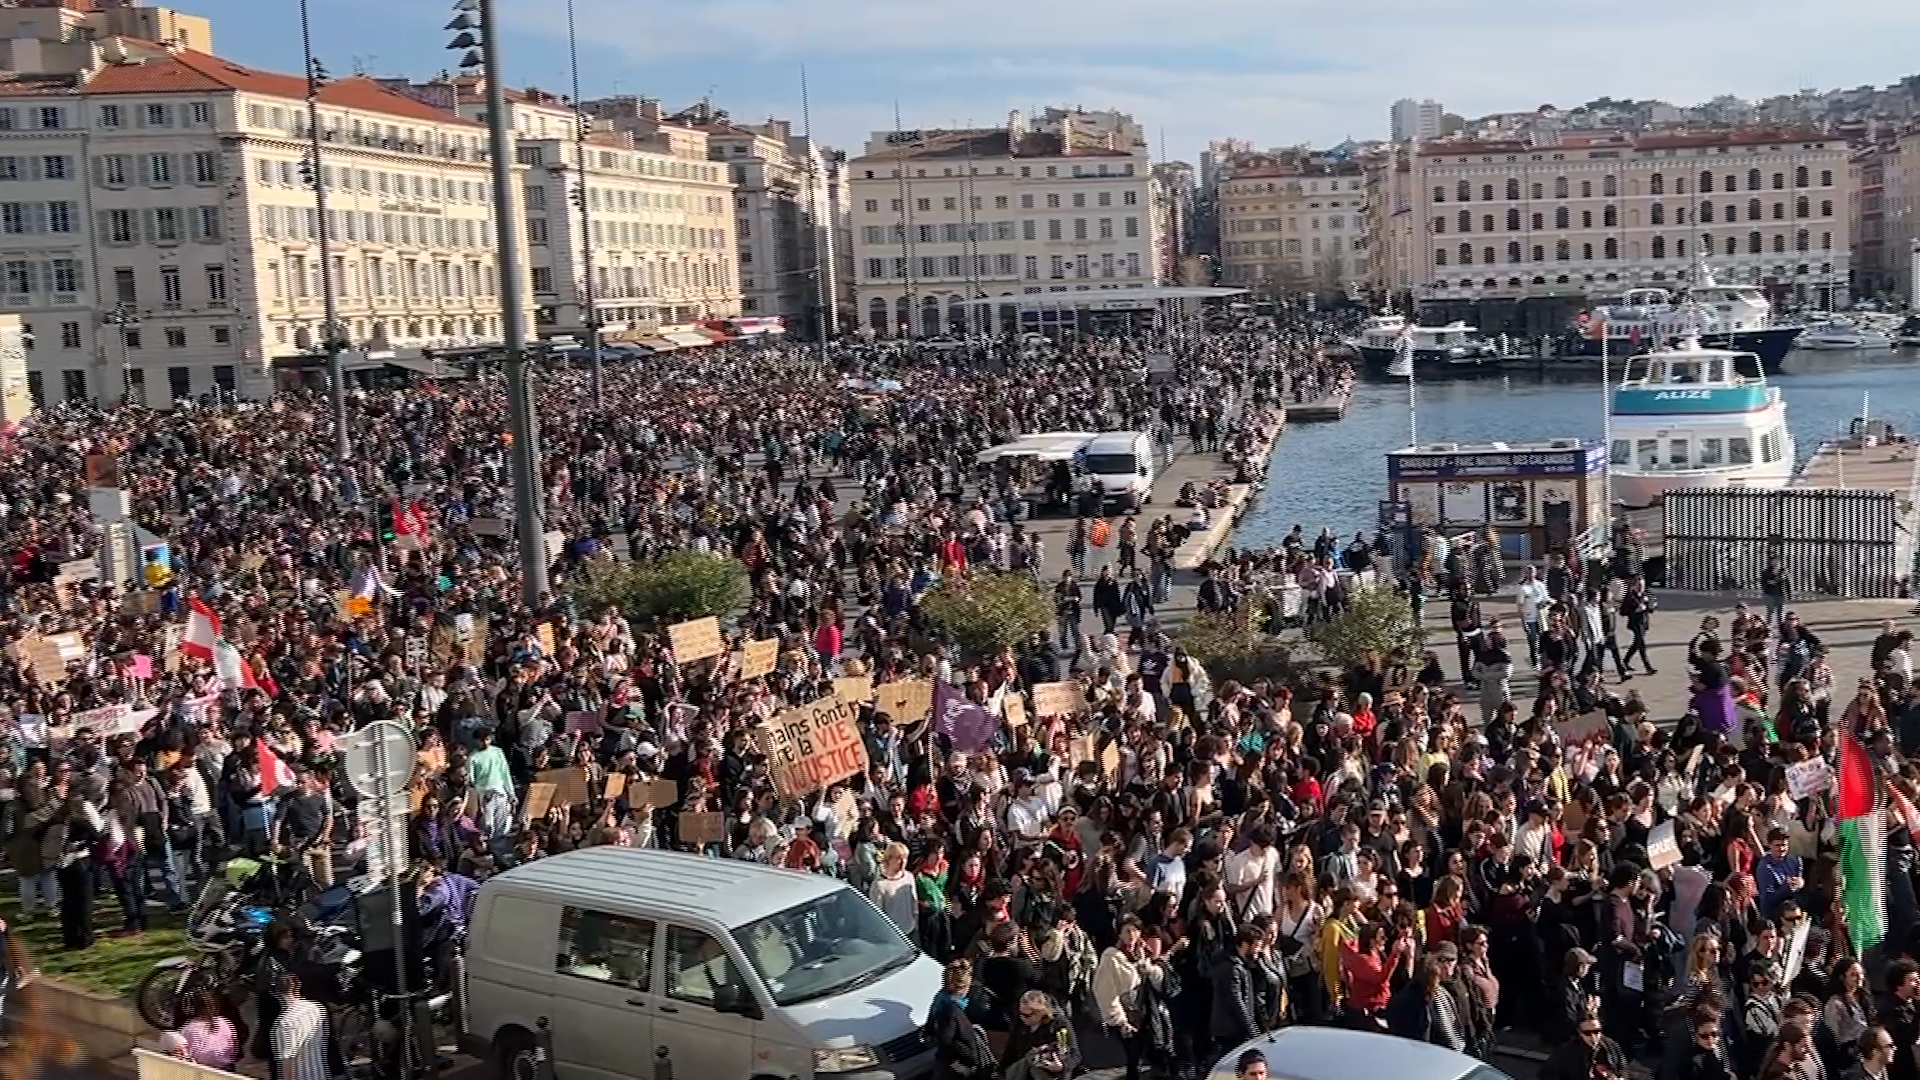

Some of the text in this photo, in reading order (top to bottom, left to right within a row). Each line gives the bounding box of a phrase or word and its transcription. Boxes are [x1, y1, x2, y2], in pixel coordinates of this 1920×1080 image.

[1455, 457, 1475, 467] PARC
[1476, 456, 1512, 467] NATIONAL
[1513, 455, 1528, 466] DES
[1529, 454, 1575, 465] CALANQUES
[813, 701, 848, 729] font
[797, 737, 814, 757] la
[815, 721, 851, 748] VIE
